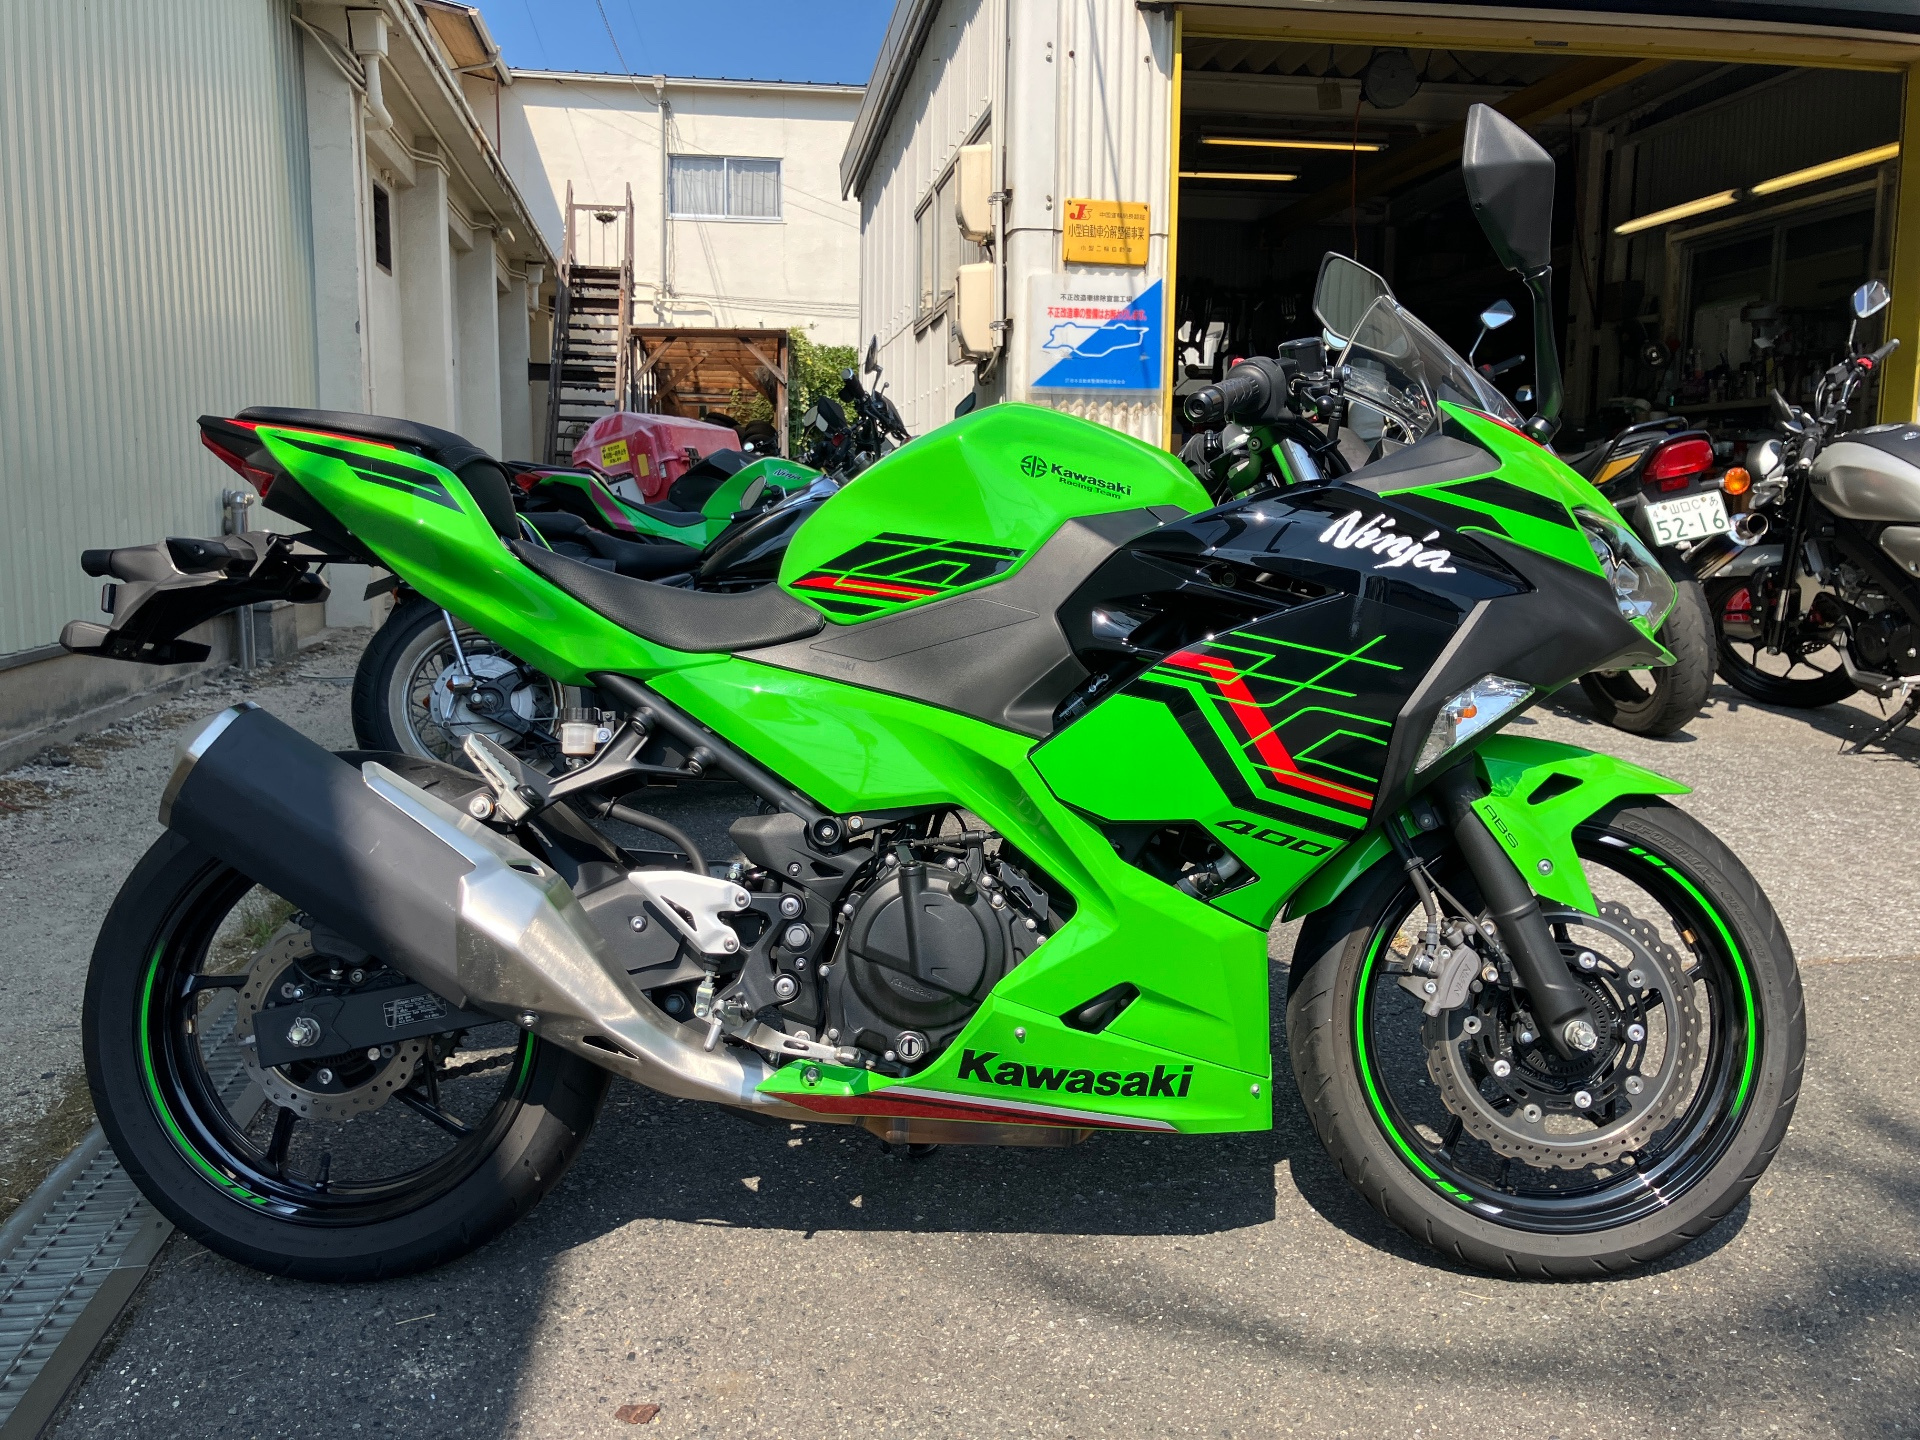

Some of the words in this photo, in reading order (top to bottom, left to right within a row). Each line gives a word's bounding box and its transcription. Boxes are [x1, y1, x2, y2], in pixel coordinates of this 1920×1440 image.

[1068, 223, 1145, 240] 小型自動車分解整備事業
[1051, 463, 1131, 495] Kawasaki
[1059, 477, 1093, 492] Racing
[1096, 487, 1121, 499] Team
[1318, 510, 1457, 573] Ninja
[1656, 509, 1725, 540] 52-16
[1213, 819, 1334, 857] 400
[1483, 804, 1519, 849] ABS
[957, 1048, 1194, 1098] Kawasaki
